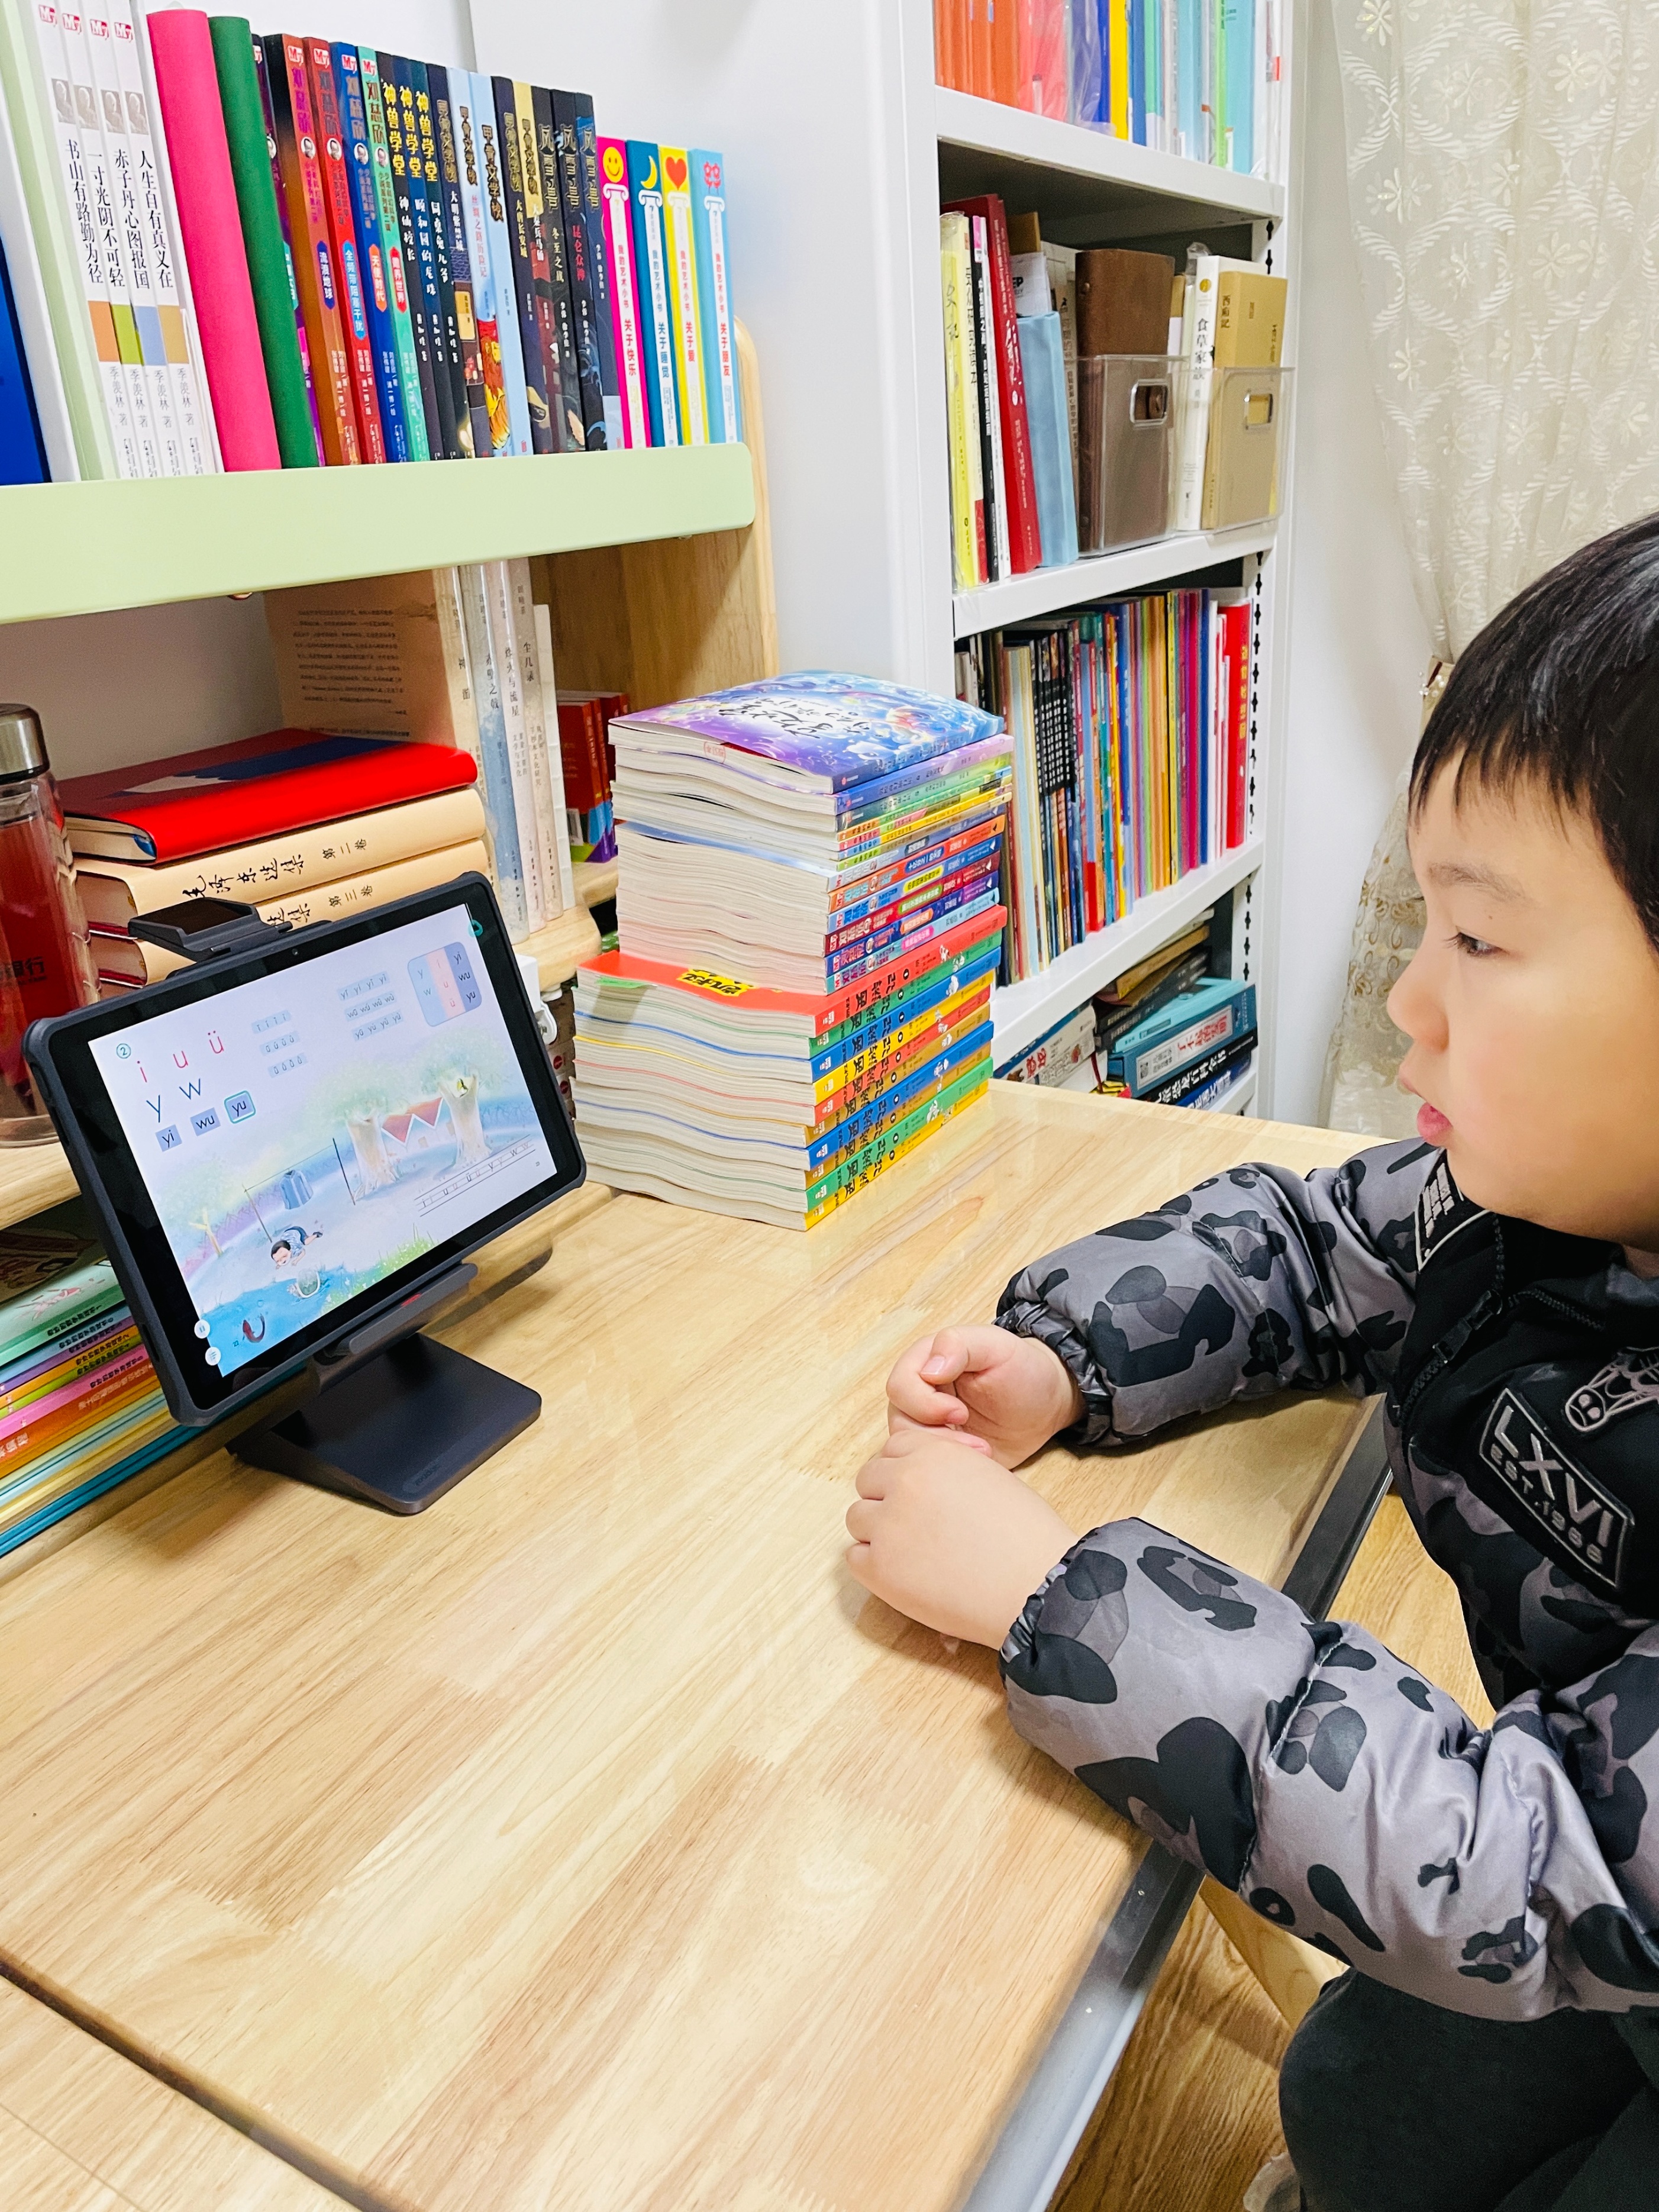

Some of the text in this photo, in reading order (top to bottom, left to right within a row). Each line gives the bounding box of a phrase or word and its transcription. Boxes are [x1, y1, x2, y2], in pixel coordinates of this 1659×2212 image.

[66, 138, 104, 284] 书山有路勤为径
[88, 153, 125, 287] 一寸光阴不可轻
[114, 149, 150, 289] 赤子丹心图报国
[139, 150, 173, 288] 人生自有真义在
[399, 196, 415, 261] 神仙校长
[625, 319, 636, 376] 关于快乐
[322, 839, 366, 860] 第二卷
[329, 885, 372, 908] 第三卷
[454, 952, 462, 965] yi
[459, 972, 470, 981] wu
[466, 991, 476, 1003] yu
[856, 972, 895, 1010] 西游记
[850, 994, 890, 1033] 西游记
[852, 1014, 891, 1055] 西游记
[137, 1030, 224, 1083] i u ü
[854, 1035, 890, 1075] 西游记
[845, 1076, 885, 1118] 西游记
[852, 1056, 889, 1097] 西游记
[146, 1078, 201, 1123] y w
[848, 1097, 886, 1140] 西游记
[162, 1101, 246, 1148] yi wu yu
[844, 1118, 883, 1160] 西游记
[844, 1157, 883, 1199] 西游记
[847, 1137, 885, 1182] 西游记
[1495, 1405, 1613, 1548] LXVI
